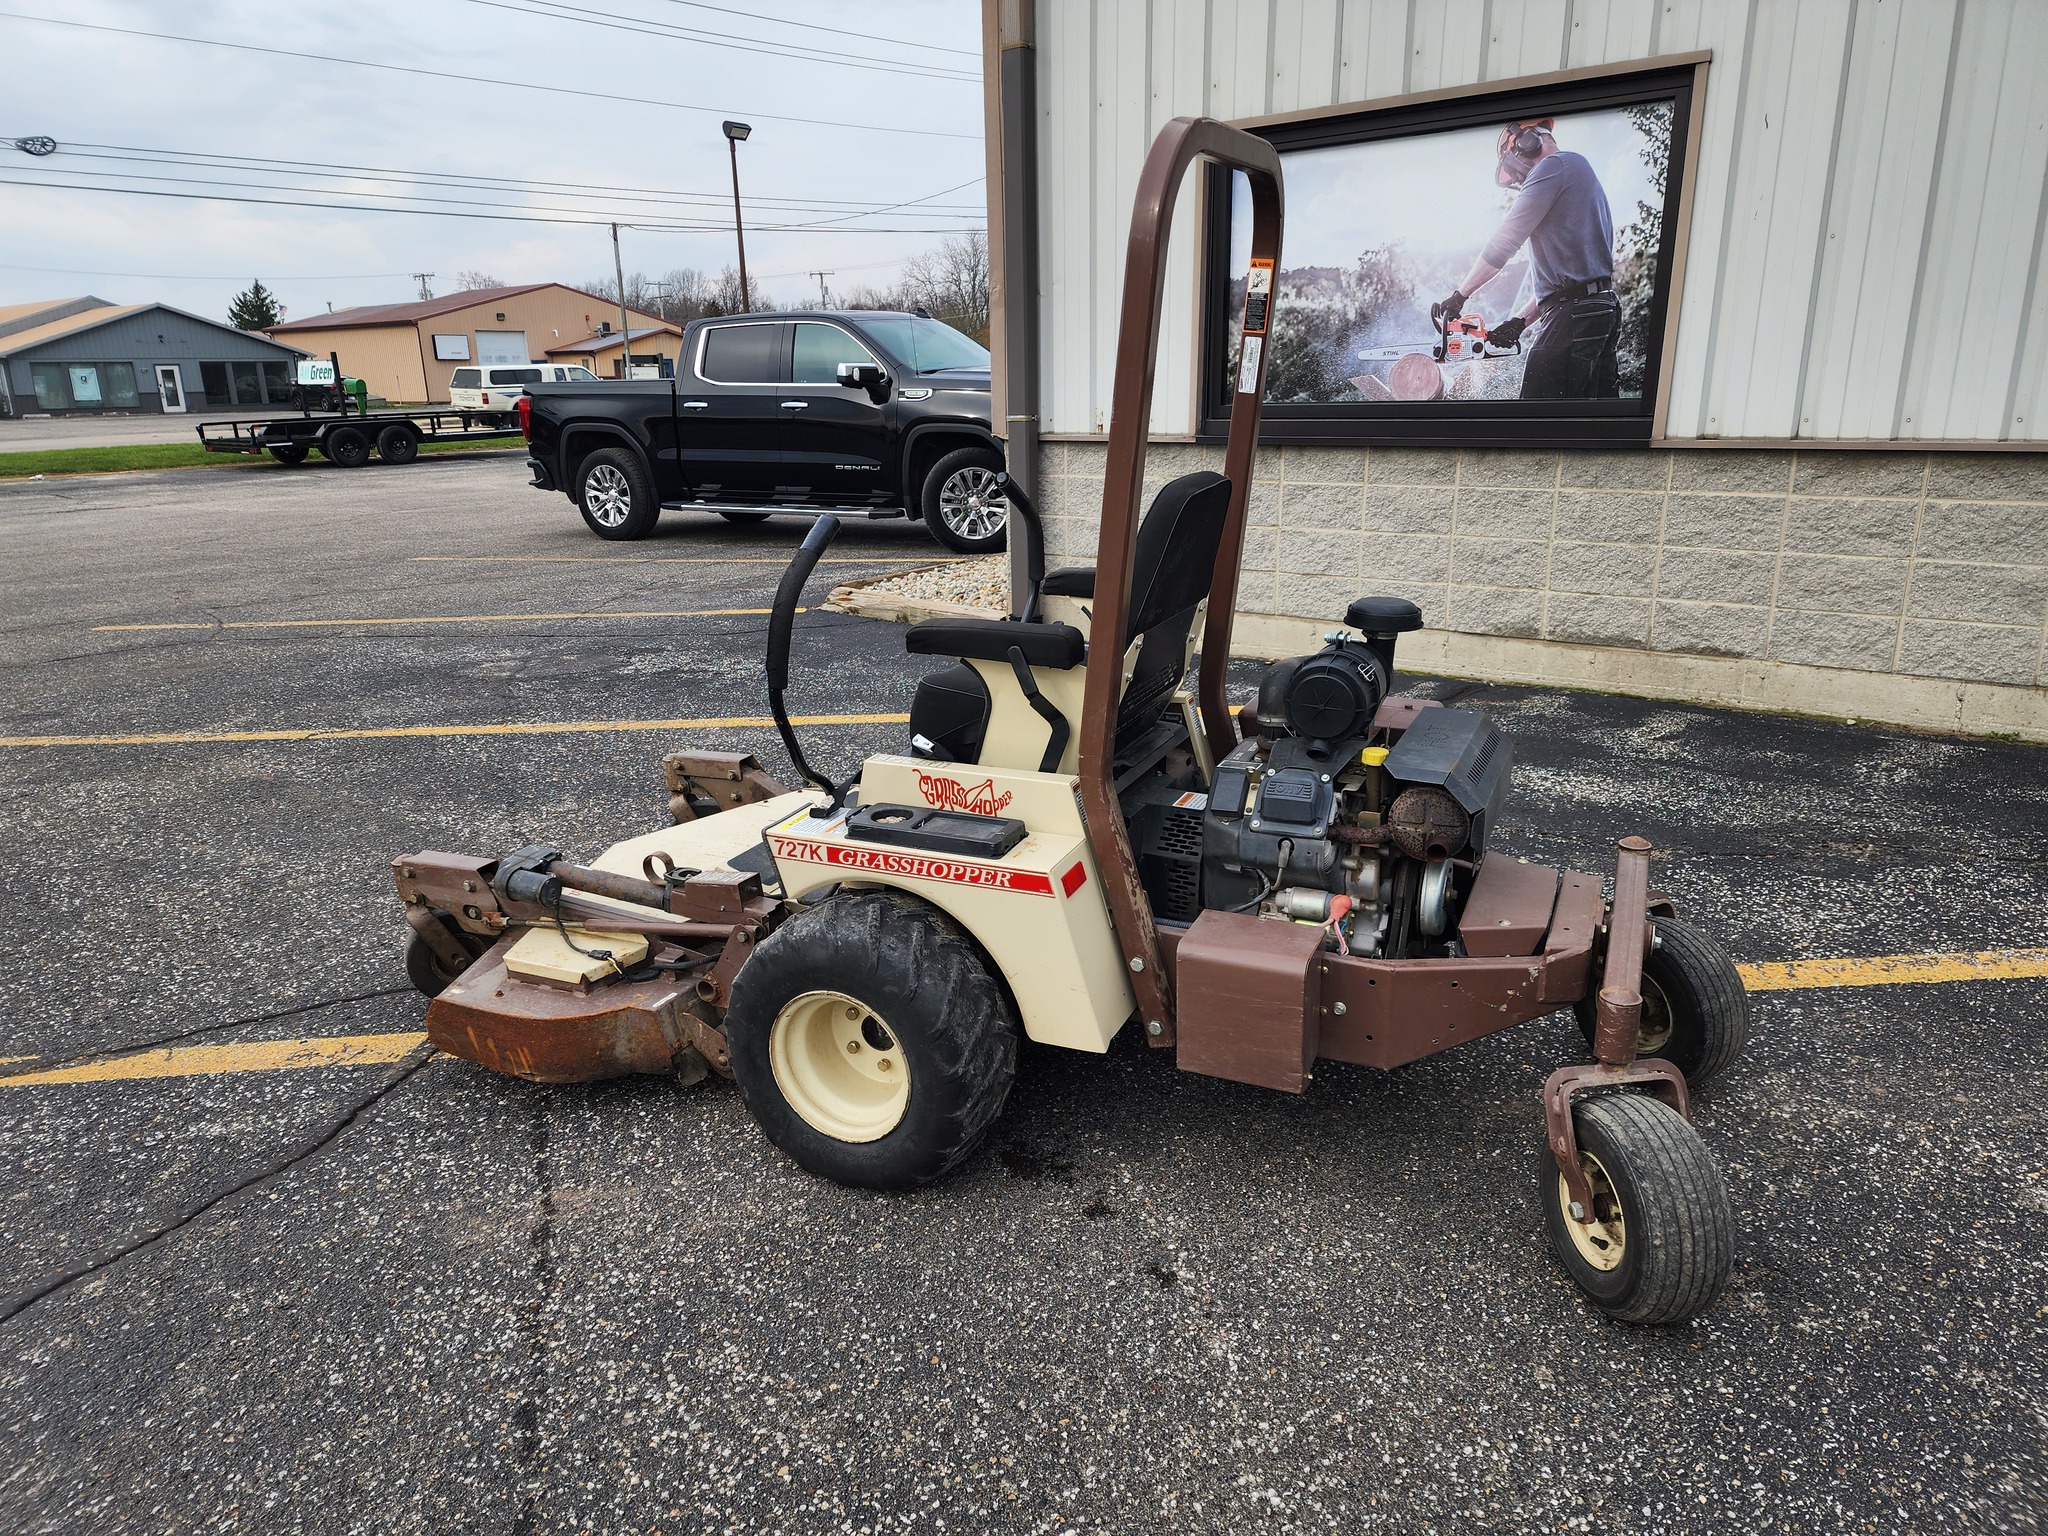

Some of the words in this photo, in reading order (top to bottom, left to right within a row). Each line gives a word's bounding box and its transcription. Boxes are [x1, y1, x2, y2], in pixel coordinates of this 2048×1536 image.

[310, 365, 333, 380] Green
[774, 839, 824, 862] 727K
[837, 849, 1012, 889] GRASSHOPPER
